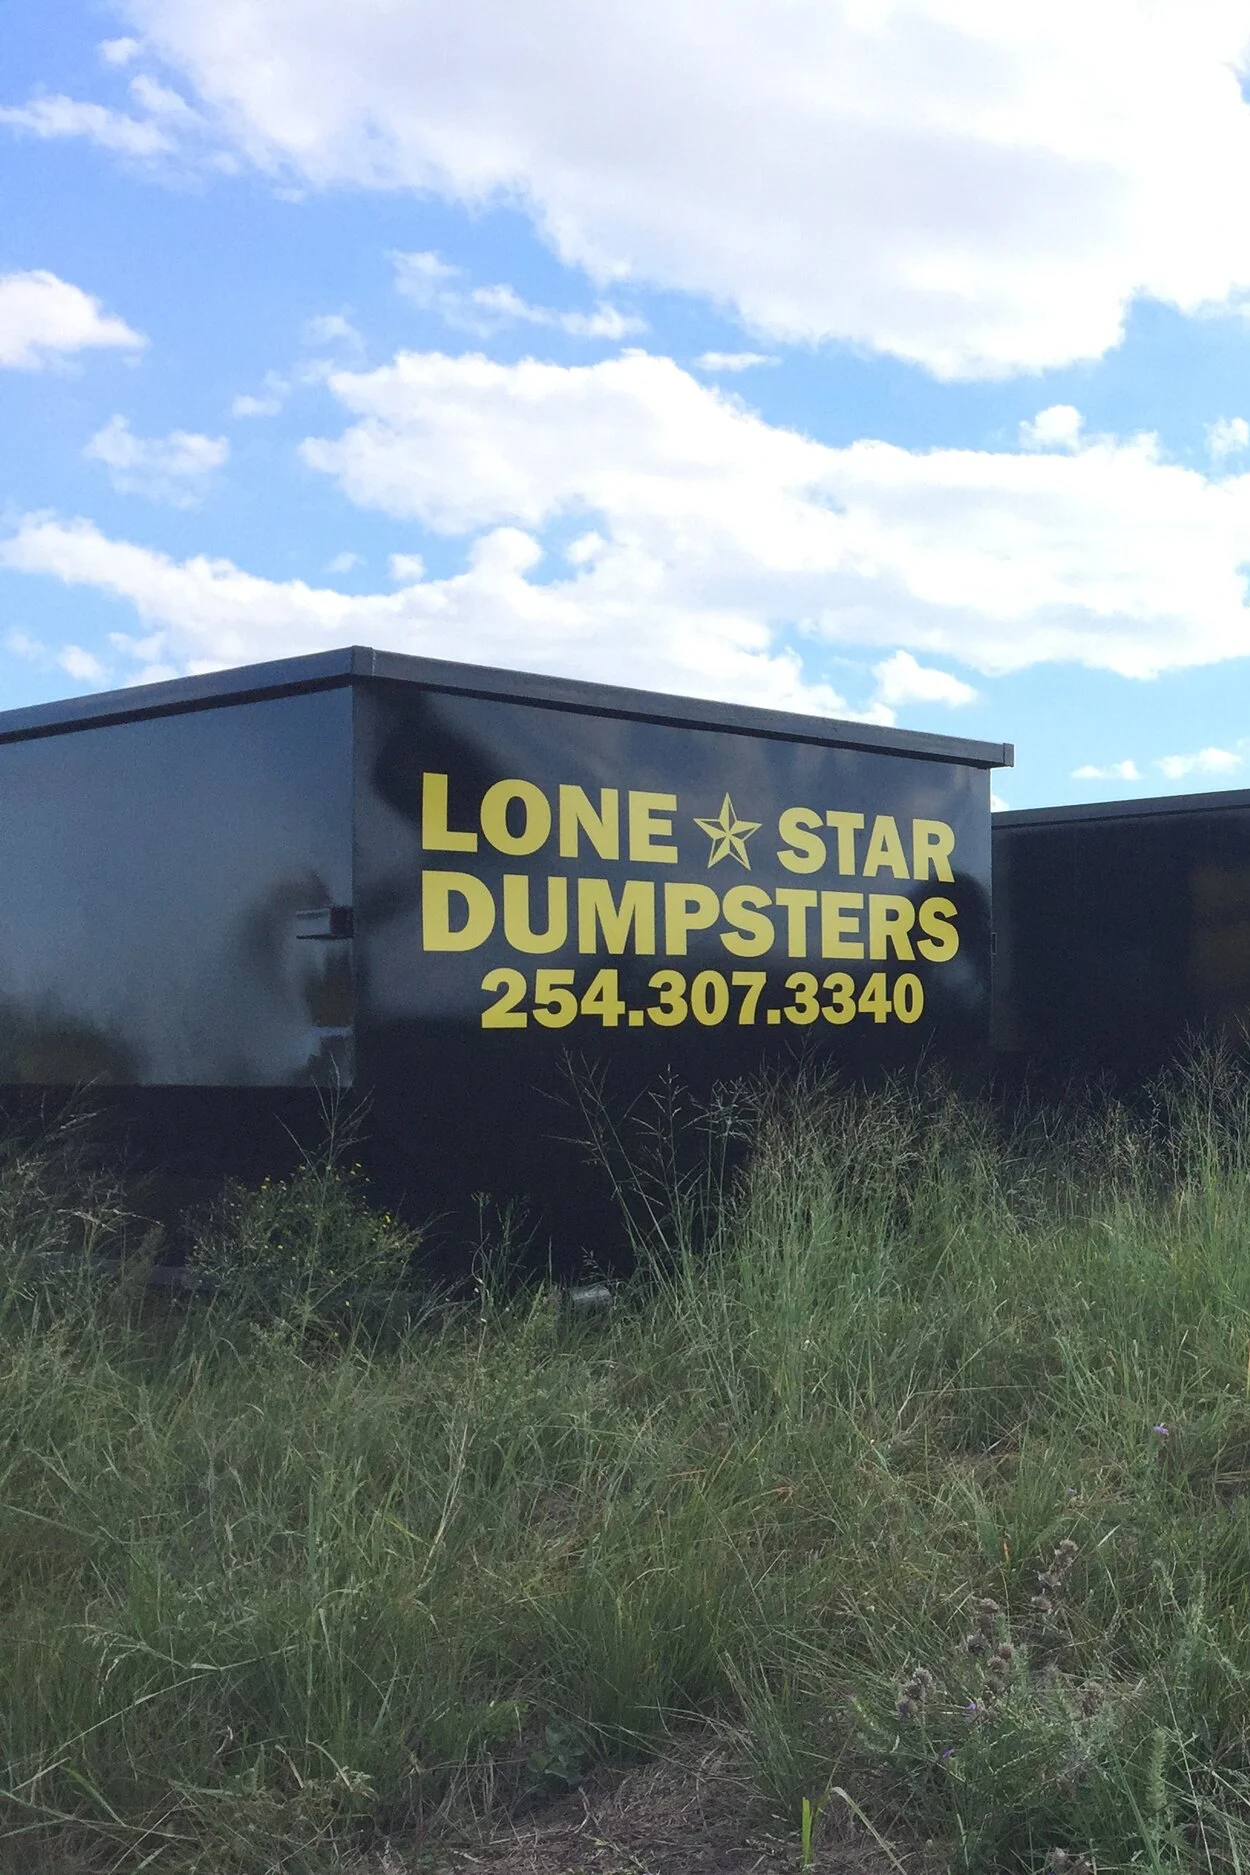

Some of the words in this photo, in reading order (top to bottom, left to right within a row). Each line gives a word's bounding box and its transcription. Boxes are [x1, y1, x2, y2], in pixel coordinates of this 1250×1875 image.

[422, 772, 678, 863] LONE
[778, 807, 955, 883] STAR
[421, 870, 960, 963] DUMPSTERS
[481, 968, 925, 1029] 254.307.3340
